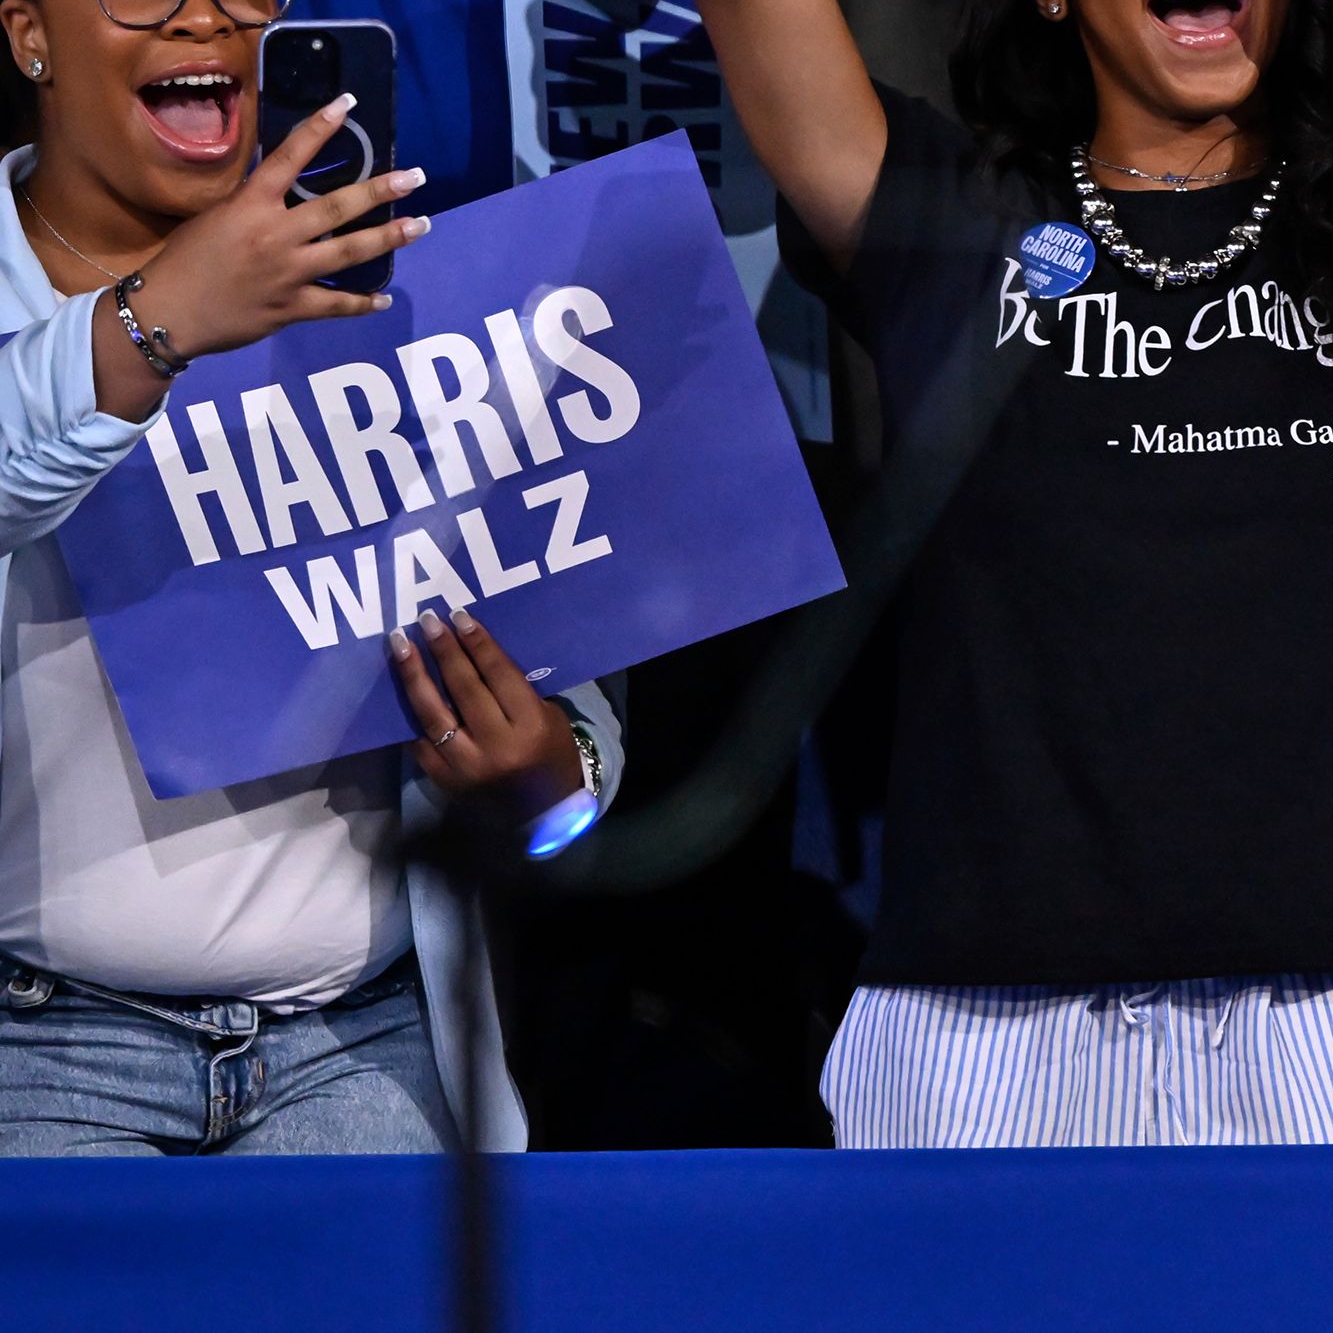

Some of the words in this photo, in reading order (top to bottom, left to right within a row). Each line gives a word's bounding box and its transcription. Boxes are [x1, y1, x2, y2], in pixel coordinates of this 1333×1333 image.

[541, 0, 631, 179] EW
[1020, 235, 1087, 274] CAROLINA
[1039, 224, 1088, 254] NORTH
[1024, 267, 1053, 286] HARRIS
[1058, 291, 1172, 378] The
[144, 284, 642, 567] HARRIS
[1130, 423, 1284, 454] Mahatma
[263, 470, 614, 651] WALZ
